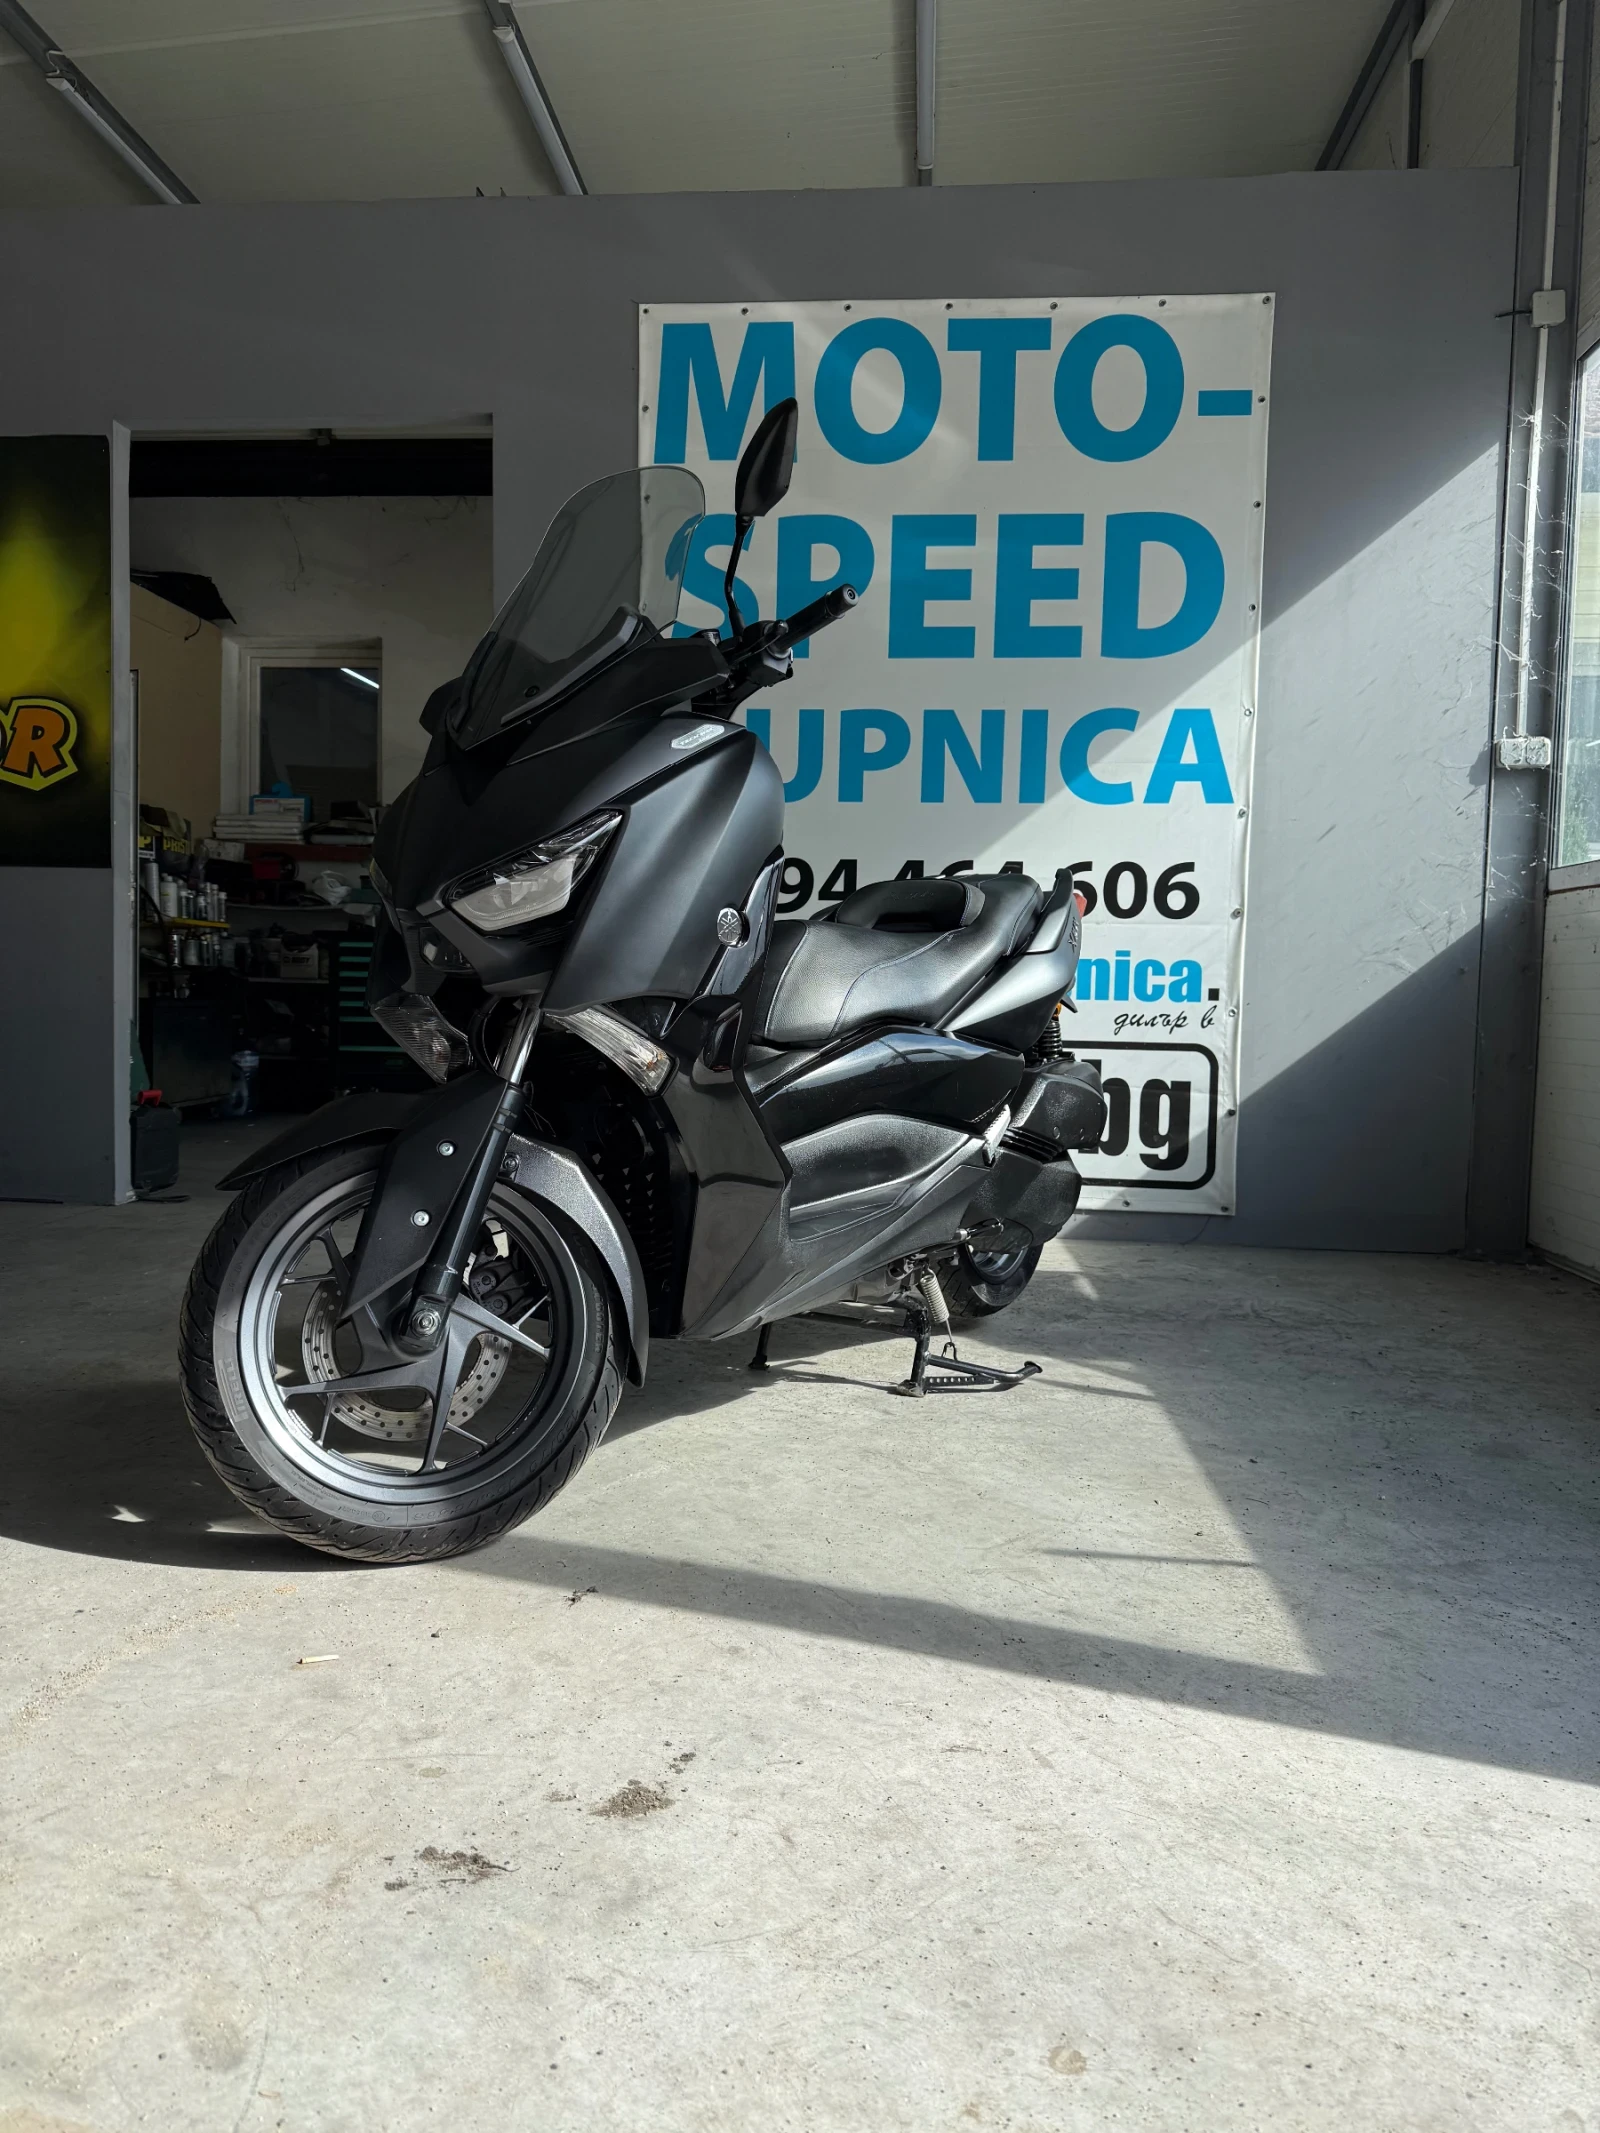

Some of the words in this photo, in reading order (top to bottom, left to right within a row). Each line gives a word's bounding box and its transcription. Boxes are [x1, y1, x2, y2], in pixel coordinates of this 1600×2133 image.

[653, 313, 1253, 465] MOTO-
[664, 511, 1225, 660] SPEED
[0, 705, 70, 780] R
[745, 707, 1234, 806] UPNICA
[775, 857, 858, 914] 94
[1064, 861, 1200, 920] 606
[1067, 950, 1220, 1003] nica.
[1114, 1011, 1189, 1036] дилър
[1200, 1005, 1218, 1029] в
